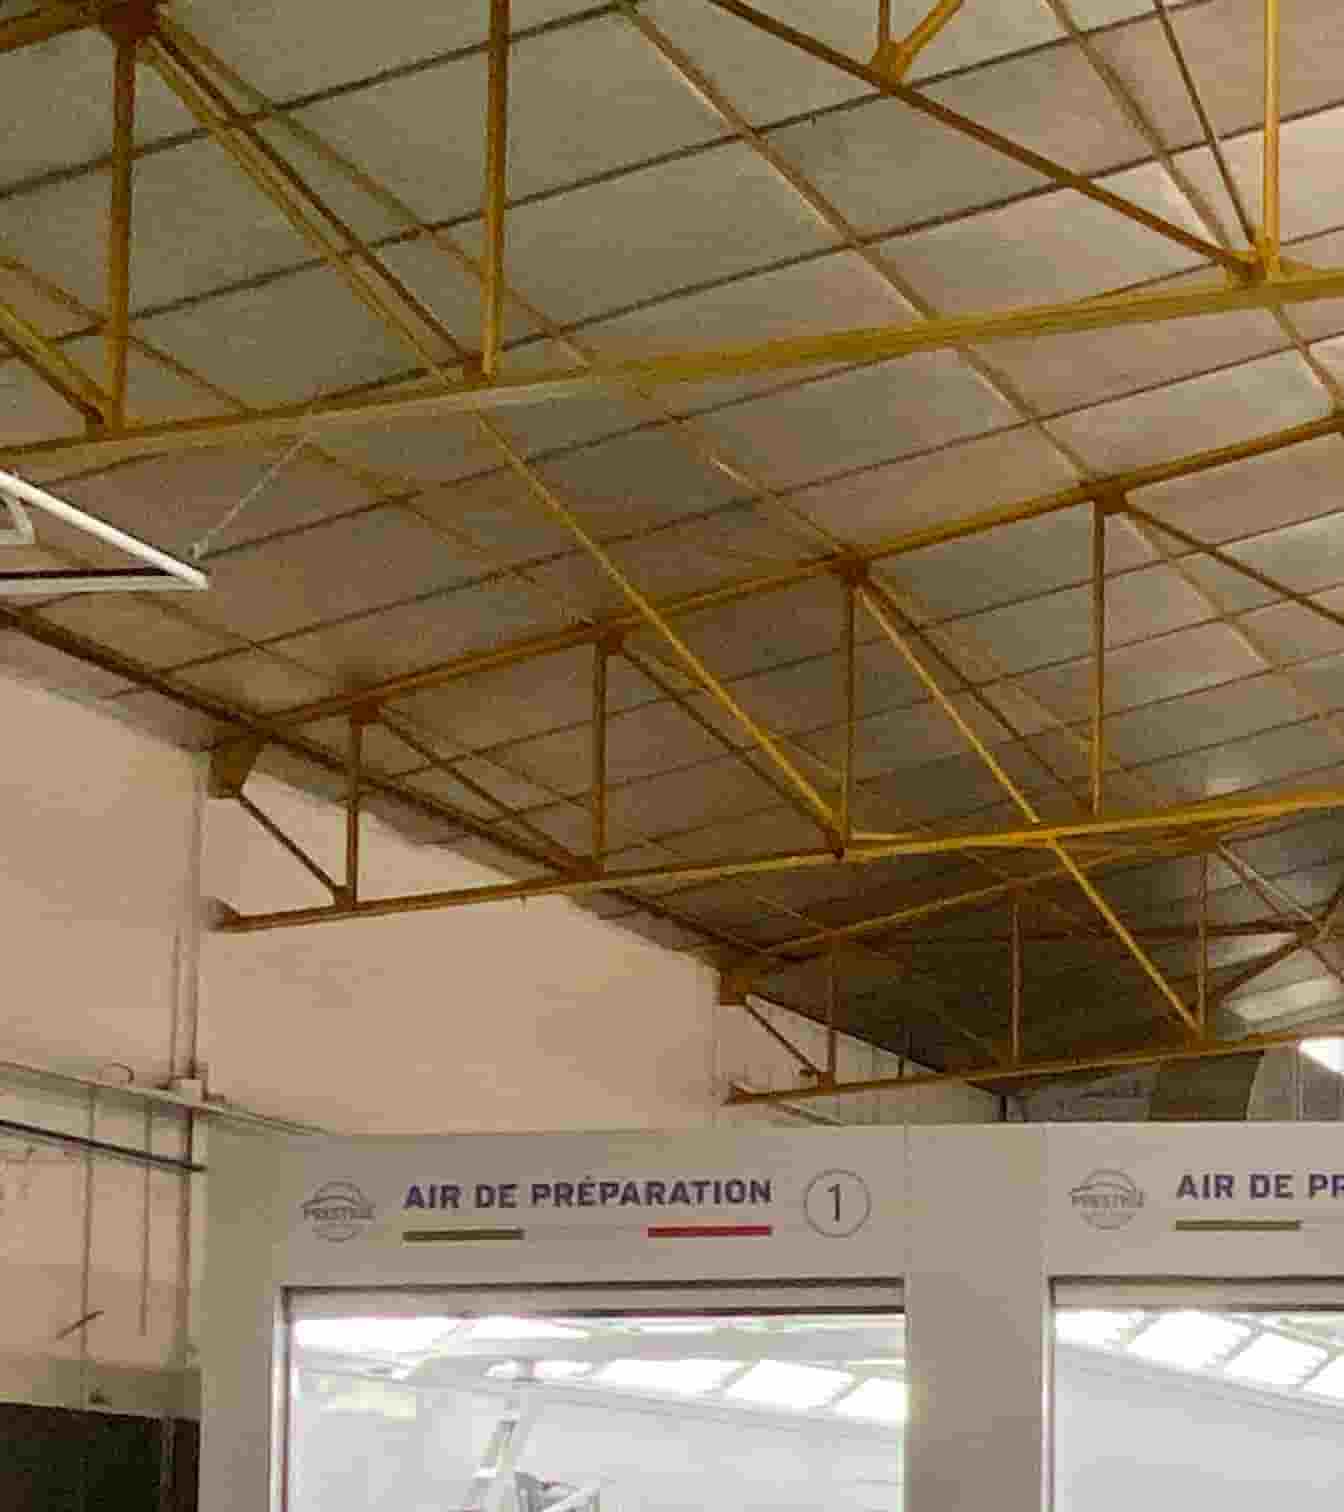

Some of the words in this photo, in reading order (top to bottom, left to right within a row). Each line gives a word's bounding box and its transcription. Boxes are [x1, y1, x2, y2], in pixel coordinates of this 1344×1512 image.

[403, 1183, 462, 1209] AIR
[475, 1183, 518, 1209] DE
[531, 1175, 773, 1208] PRÉPARATION
[826, 1182, 842, 1222] 1
[1176, 1173, 1235, 1200] AIR
[1248, 1173, 1294, 1200] DE
